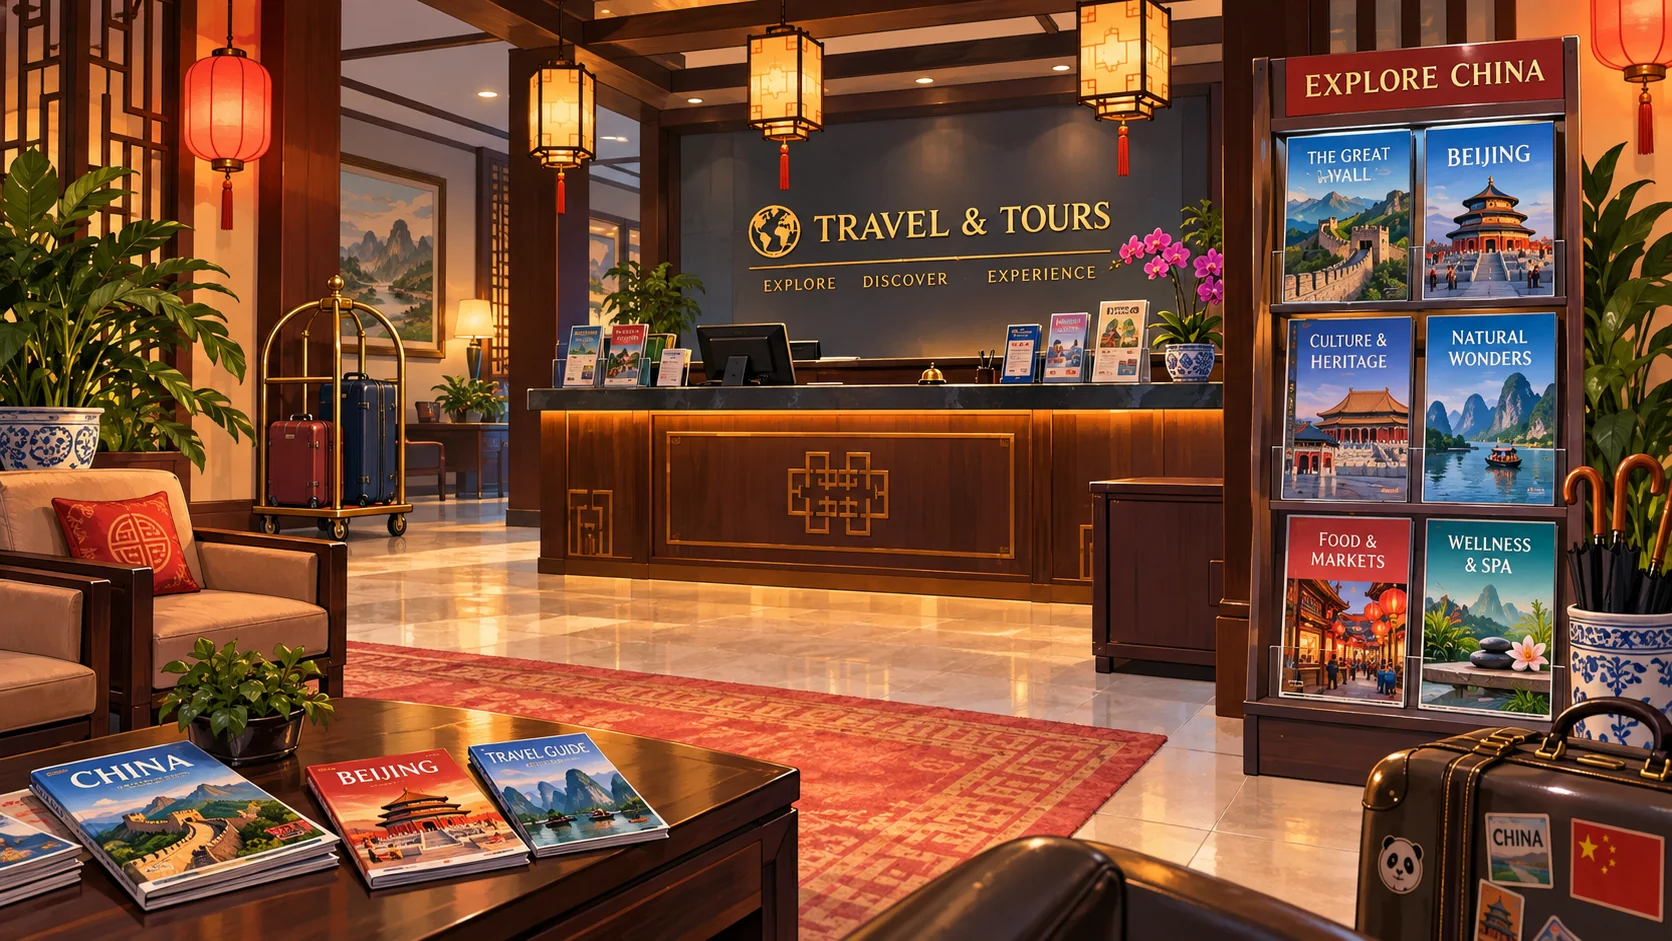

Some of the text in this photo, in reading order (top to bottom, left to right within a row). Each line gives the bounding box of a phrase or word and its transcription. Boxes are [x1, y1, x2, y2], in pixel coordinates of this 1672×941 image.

[1305, 59, 1545, 98] EXPLORE CHINA
[1307, 147, 1390, 165] THE GREAT
[1447, 144, 1531, 168] BEIJING
[813, 202, 1112, 243] TRAVEL & TOURS
[763, 265, 1096, 293] EXPLORE DISCOVER EXPERIENCE
[1310, 333, 1387, 349] CULTURE &
[1452, 329, 1528, 346] NATURAL
[1311, 354, 1387, 369] HERITAGE
[1448, 350, 1532, 367] WONDERS
[1319, 531, 1377, 549] FOOD &
[1448, 535, 1531, 553] WELLNESS
[1311, 552, 1385, 569] MARKETS
[1465, 558, 1512, 575] & SPA
[484, 748, 544, 764] TRAVEL
[544, 742, 590, 757] GUIDE
[70, 754, 195, 789] CHINA
[336, 760, 439, 785] BEIJING
[1492, 828, 1544, 848] CHINA
